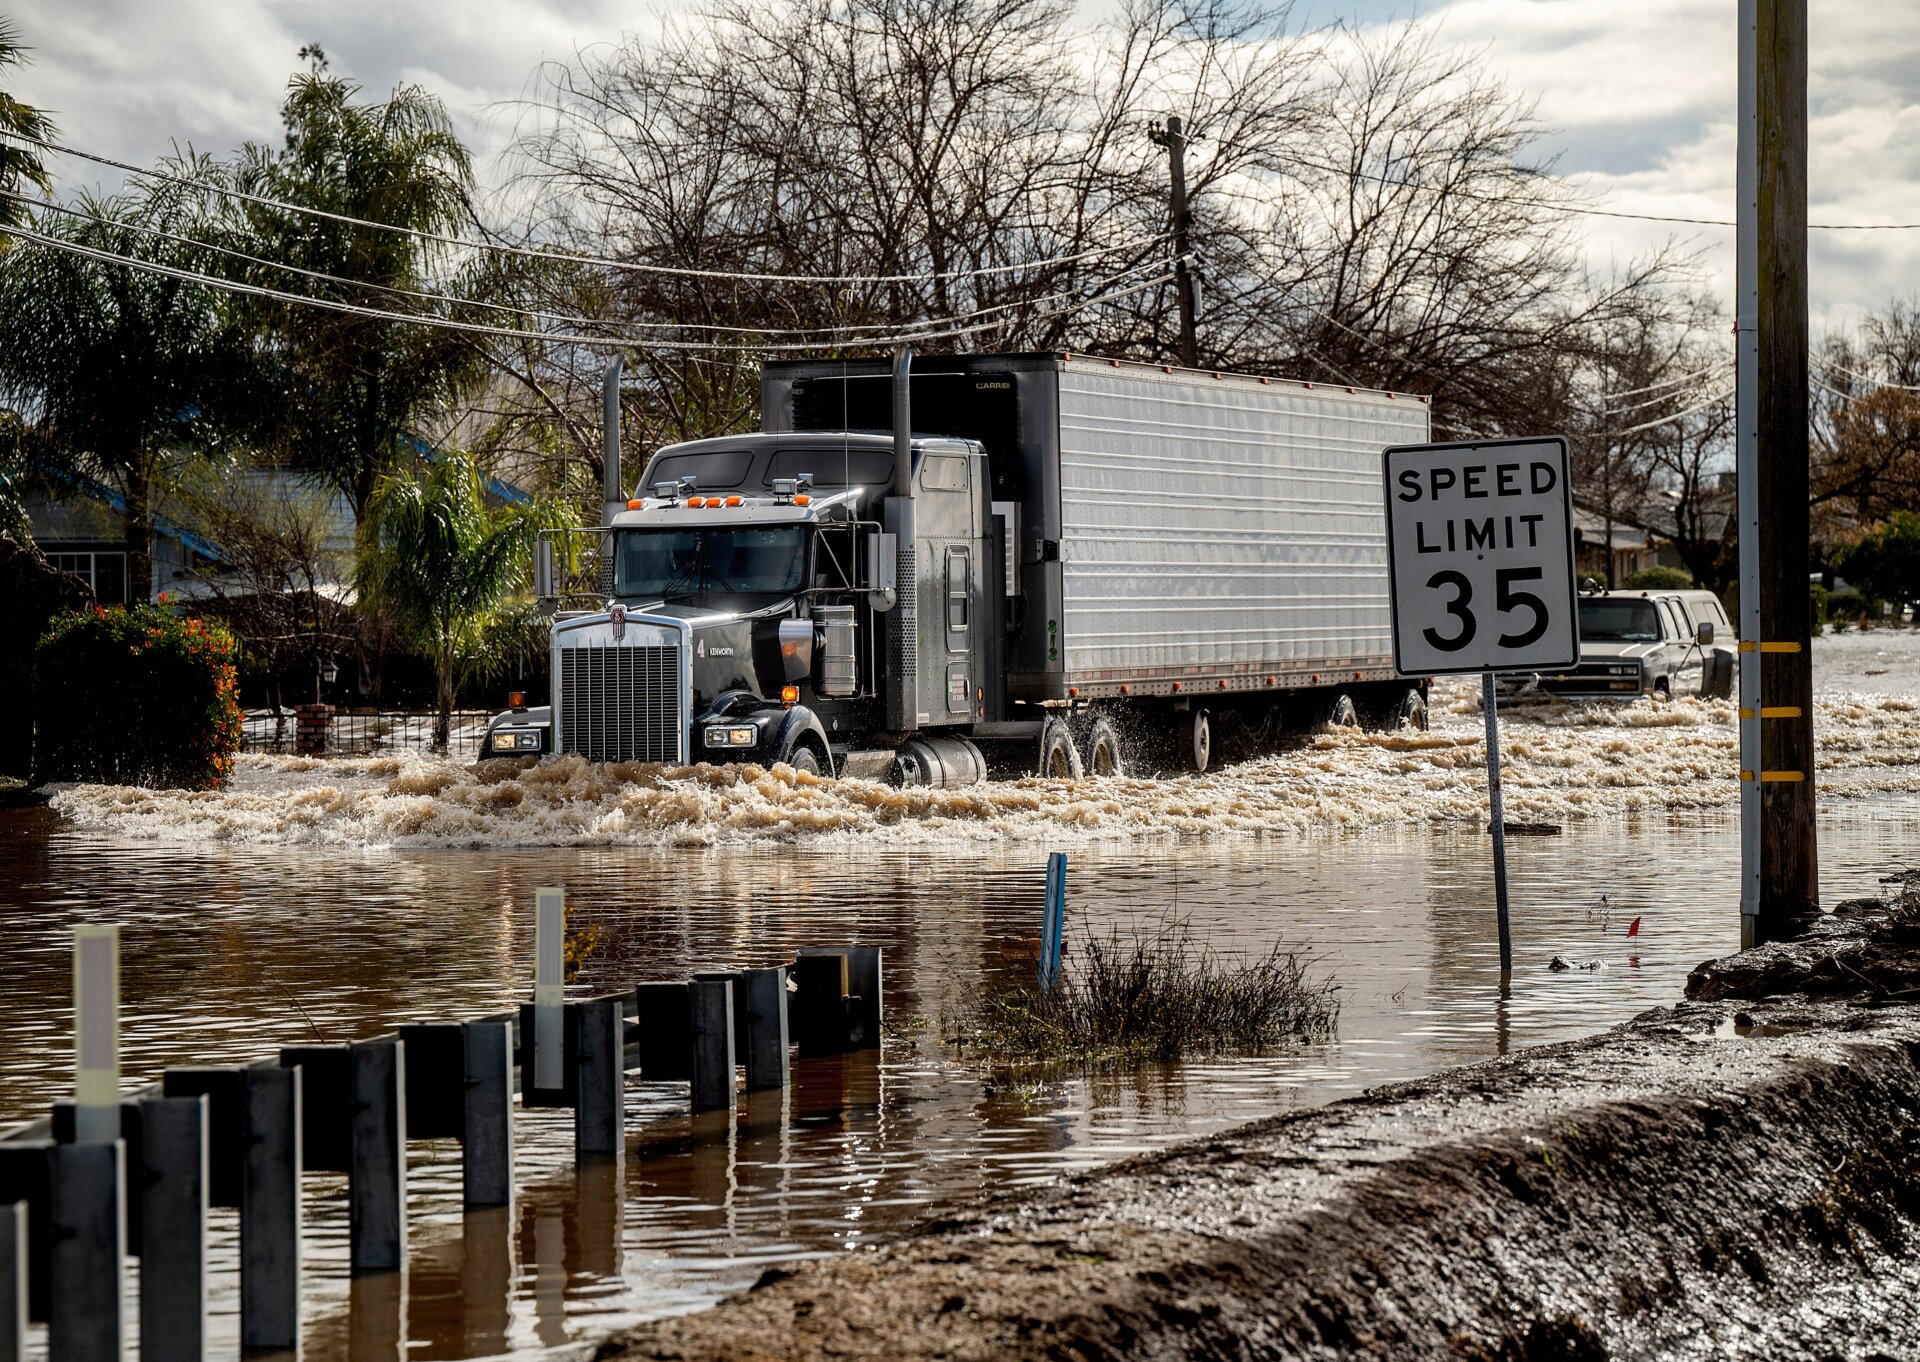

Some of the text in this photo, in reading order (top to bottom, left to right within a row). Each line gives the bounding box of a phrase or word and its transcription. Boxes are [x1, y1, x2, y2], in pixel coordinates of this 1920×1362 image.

[1398, 462, 1557, 502] SPEED
[1416, 514, 1544, 553] LIMIT
[1422, 566, 1549, 652] 35
[697, 639, 706, 658] 4
